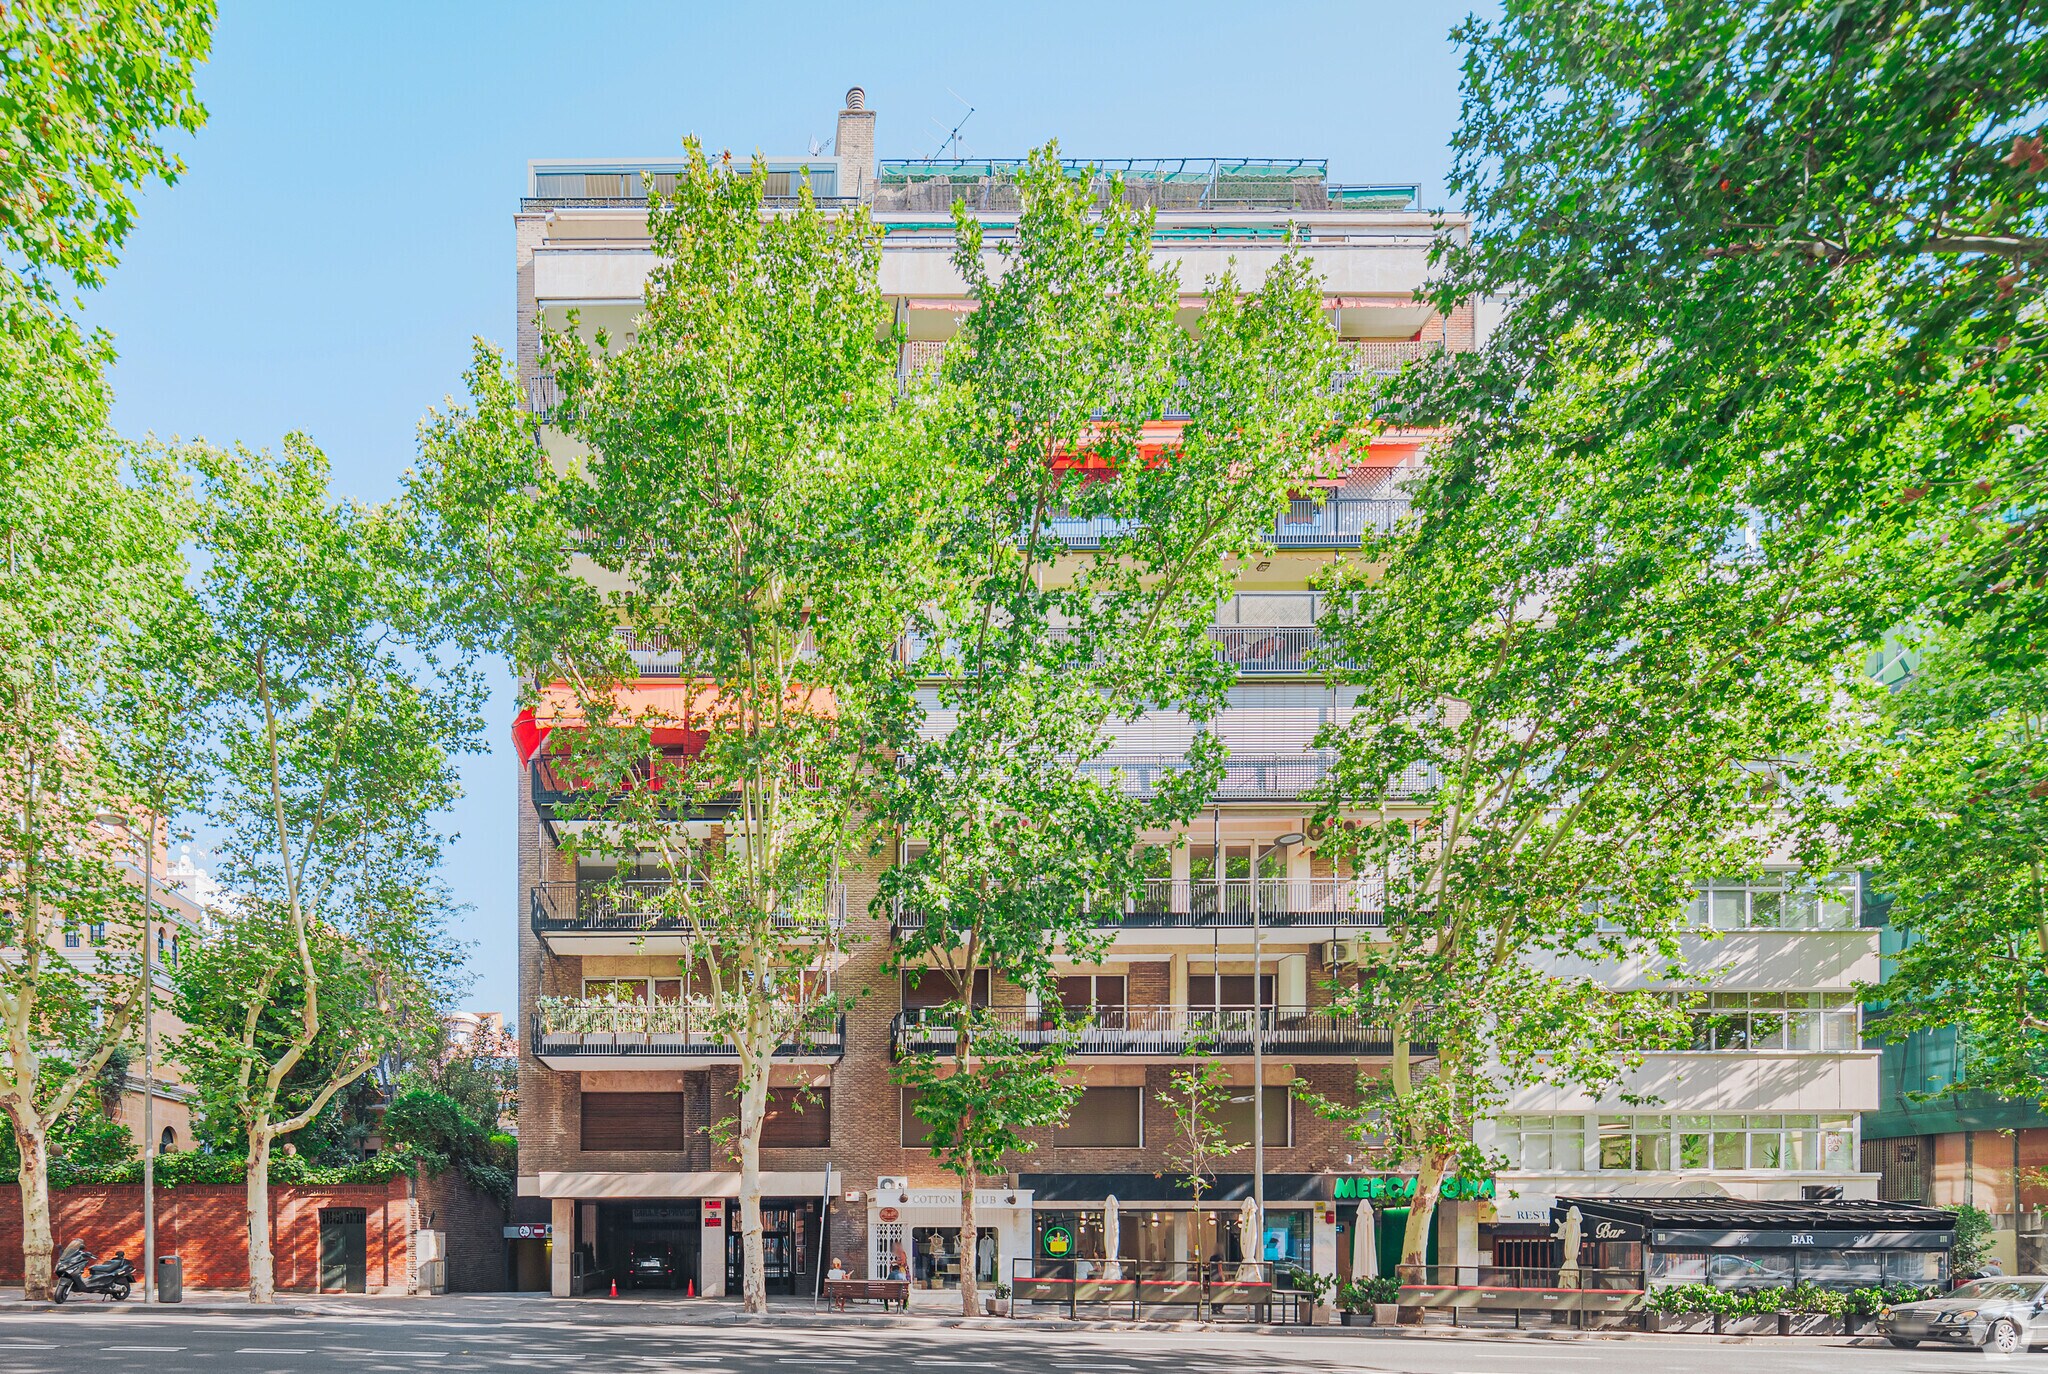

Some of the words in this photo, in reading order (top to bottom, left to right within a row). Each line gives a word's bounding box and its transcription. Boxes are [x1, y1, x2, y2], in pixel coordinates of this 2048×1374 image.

[1334, 1177, 1496, 1199] MERCAONA
[912, 1195, 955, 1204] COTTON
[974, 1196, 997, 1204] LUB
[1517, 1210, 1550, 1219] REST
[1595, 1222, 1626, 1239] Bar
[1791, 1235, 1814, 1245] BAR
